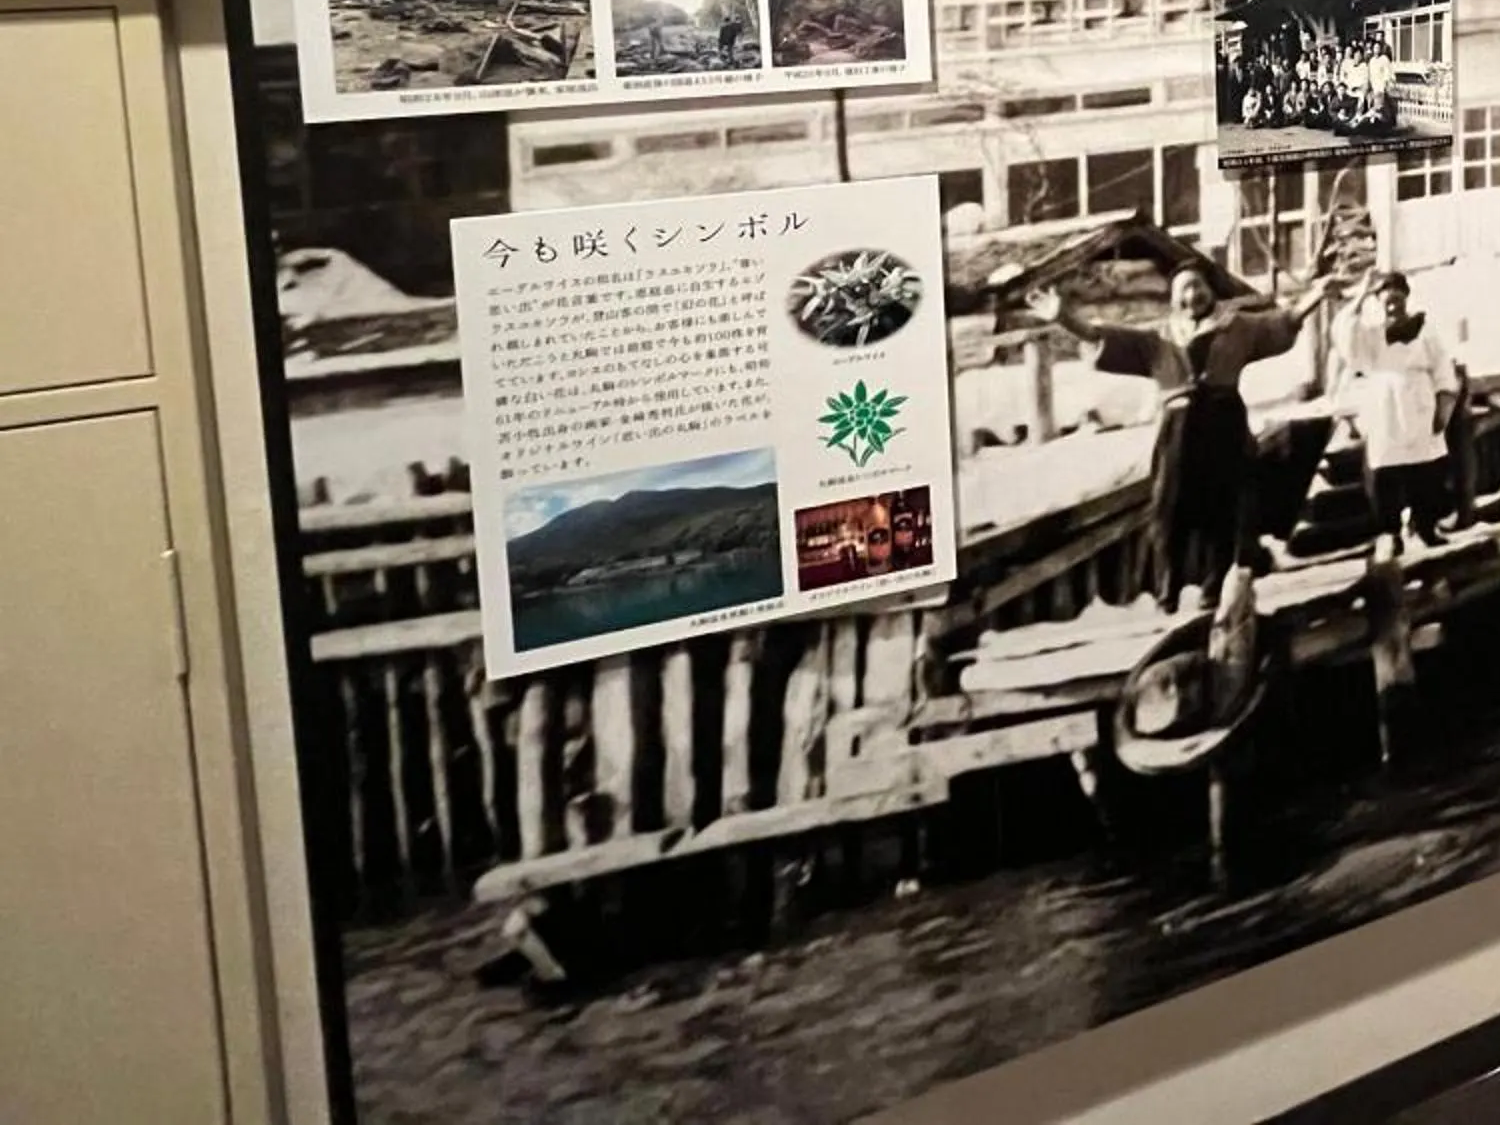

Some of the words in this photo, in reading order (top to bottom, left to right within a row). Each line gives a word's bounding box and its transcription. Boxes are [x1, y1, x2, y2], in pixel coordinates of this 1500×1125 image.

[482, 211, 811, 268] 今も咲くシンボル
